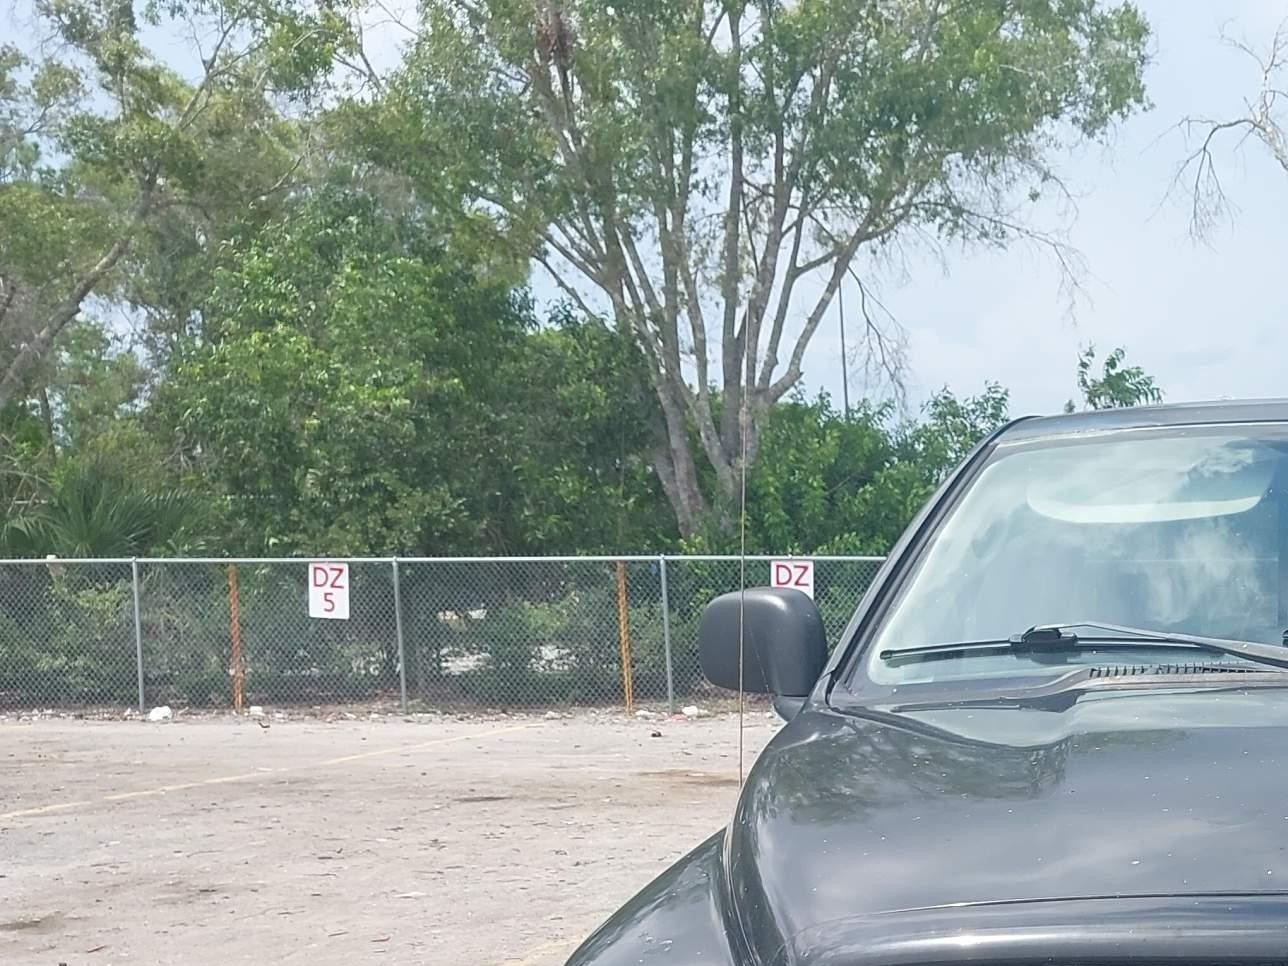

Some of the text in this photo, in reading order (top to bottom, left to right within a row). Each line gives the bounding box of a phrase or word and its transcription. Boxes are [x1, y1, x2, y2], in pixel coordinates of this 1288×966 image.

[313, 566, 344, 589] DZ
[776, 564, 809, 586] DZ
[323, 592, 336, 612] 5
